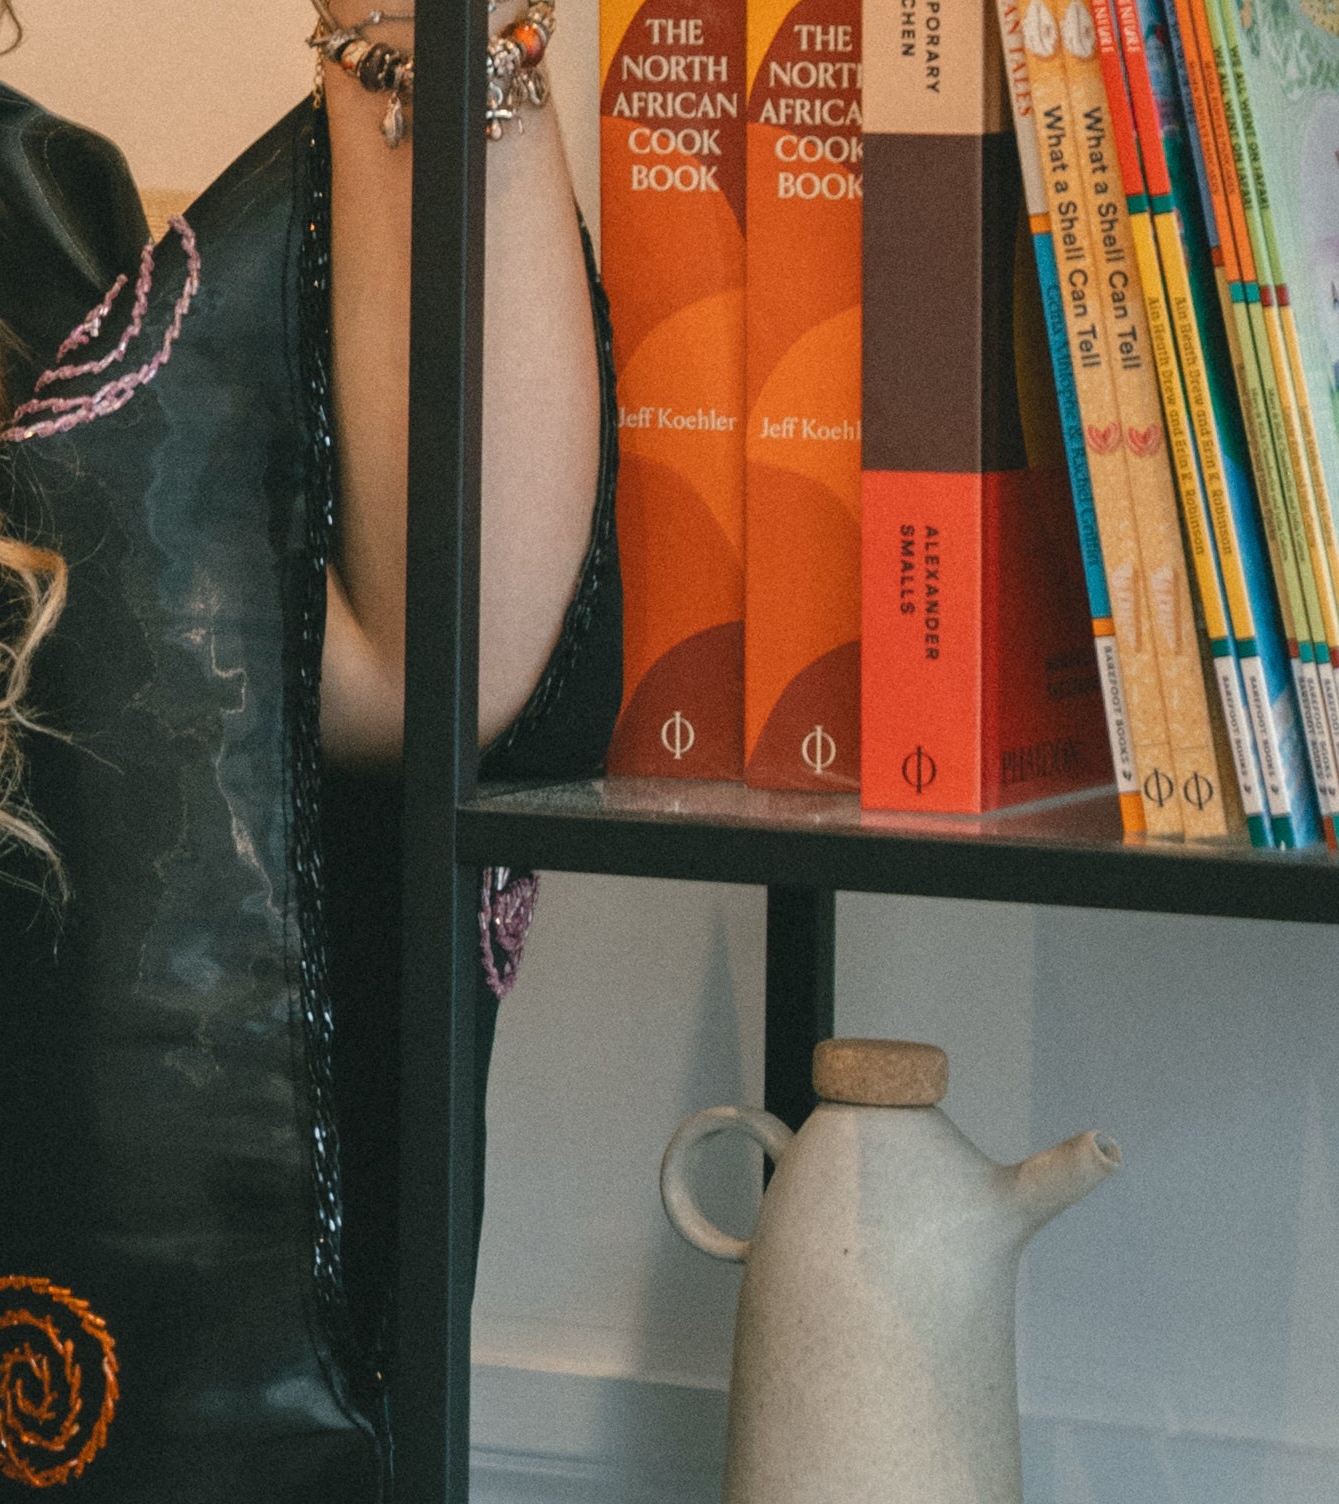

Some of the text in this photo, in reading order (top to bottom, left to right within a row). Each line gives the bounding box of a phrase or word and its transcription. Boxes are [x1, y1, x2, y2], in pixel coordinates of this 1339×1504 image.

[645, 18, 705, 45] THE
[793, 24, 853, 52] THE
[621, 54, 729, 83] NORTH
[1009, 46, 1034, 116] TALES
[612, 92, 738, 119] AFRICAN
[758, 97, 863, 126] AFRICA
[628, 128, 722, 156] COOK
[630, 164, 720, 192] BOOK
[1043, 105, 1101, 369] What a Shell Can Tell
[1083, 106, 1142, 370] What a Shell Can Tell
[1161, 368, 1177, 406] Drew
[1188, 368, 1205, 406] Drew
[618, 406, 739, 432] Jeff Koehler
[759, 416, 862, 441] Jeff Koehl
[1169, 407, 1183, 436] and
[1196, 407, 1210, 436] and
[1174, 439, 1189, 469] Erin
[1201, 439, 1217, 469] Erin
[1184, 488, 1205, 556] Robinson
[1211, 488, 1233, 556] Robinson
[900, 524, 915, 615] SMALLS
[925, 525, 940, 661] ALEXANDER
[1103, 644, 1129, 764] BAREFOOT BOOKS
[1222, 675, 1248, 777] BAREFOOT BOOKS
[1249, 674, 1276, 778] BAREFOOT BOOKS
